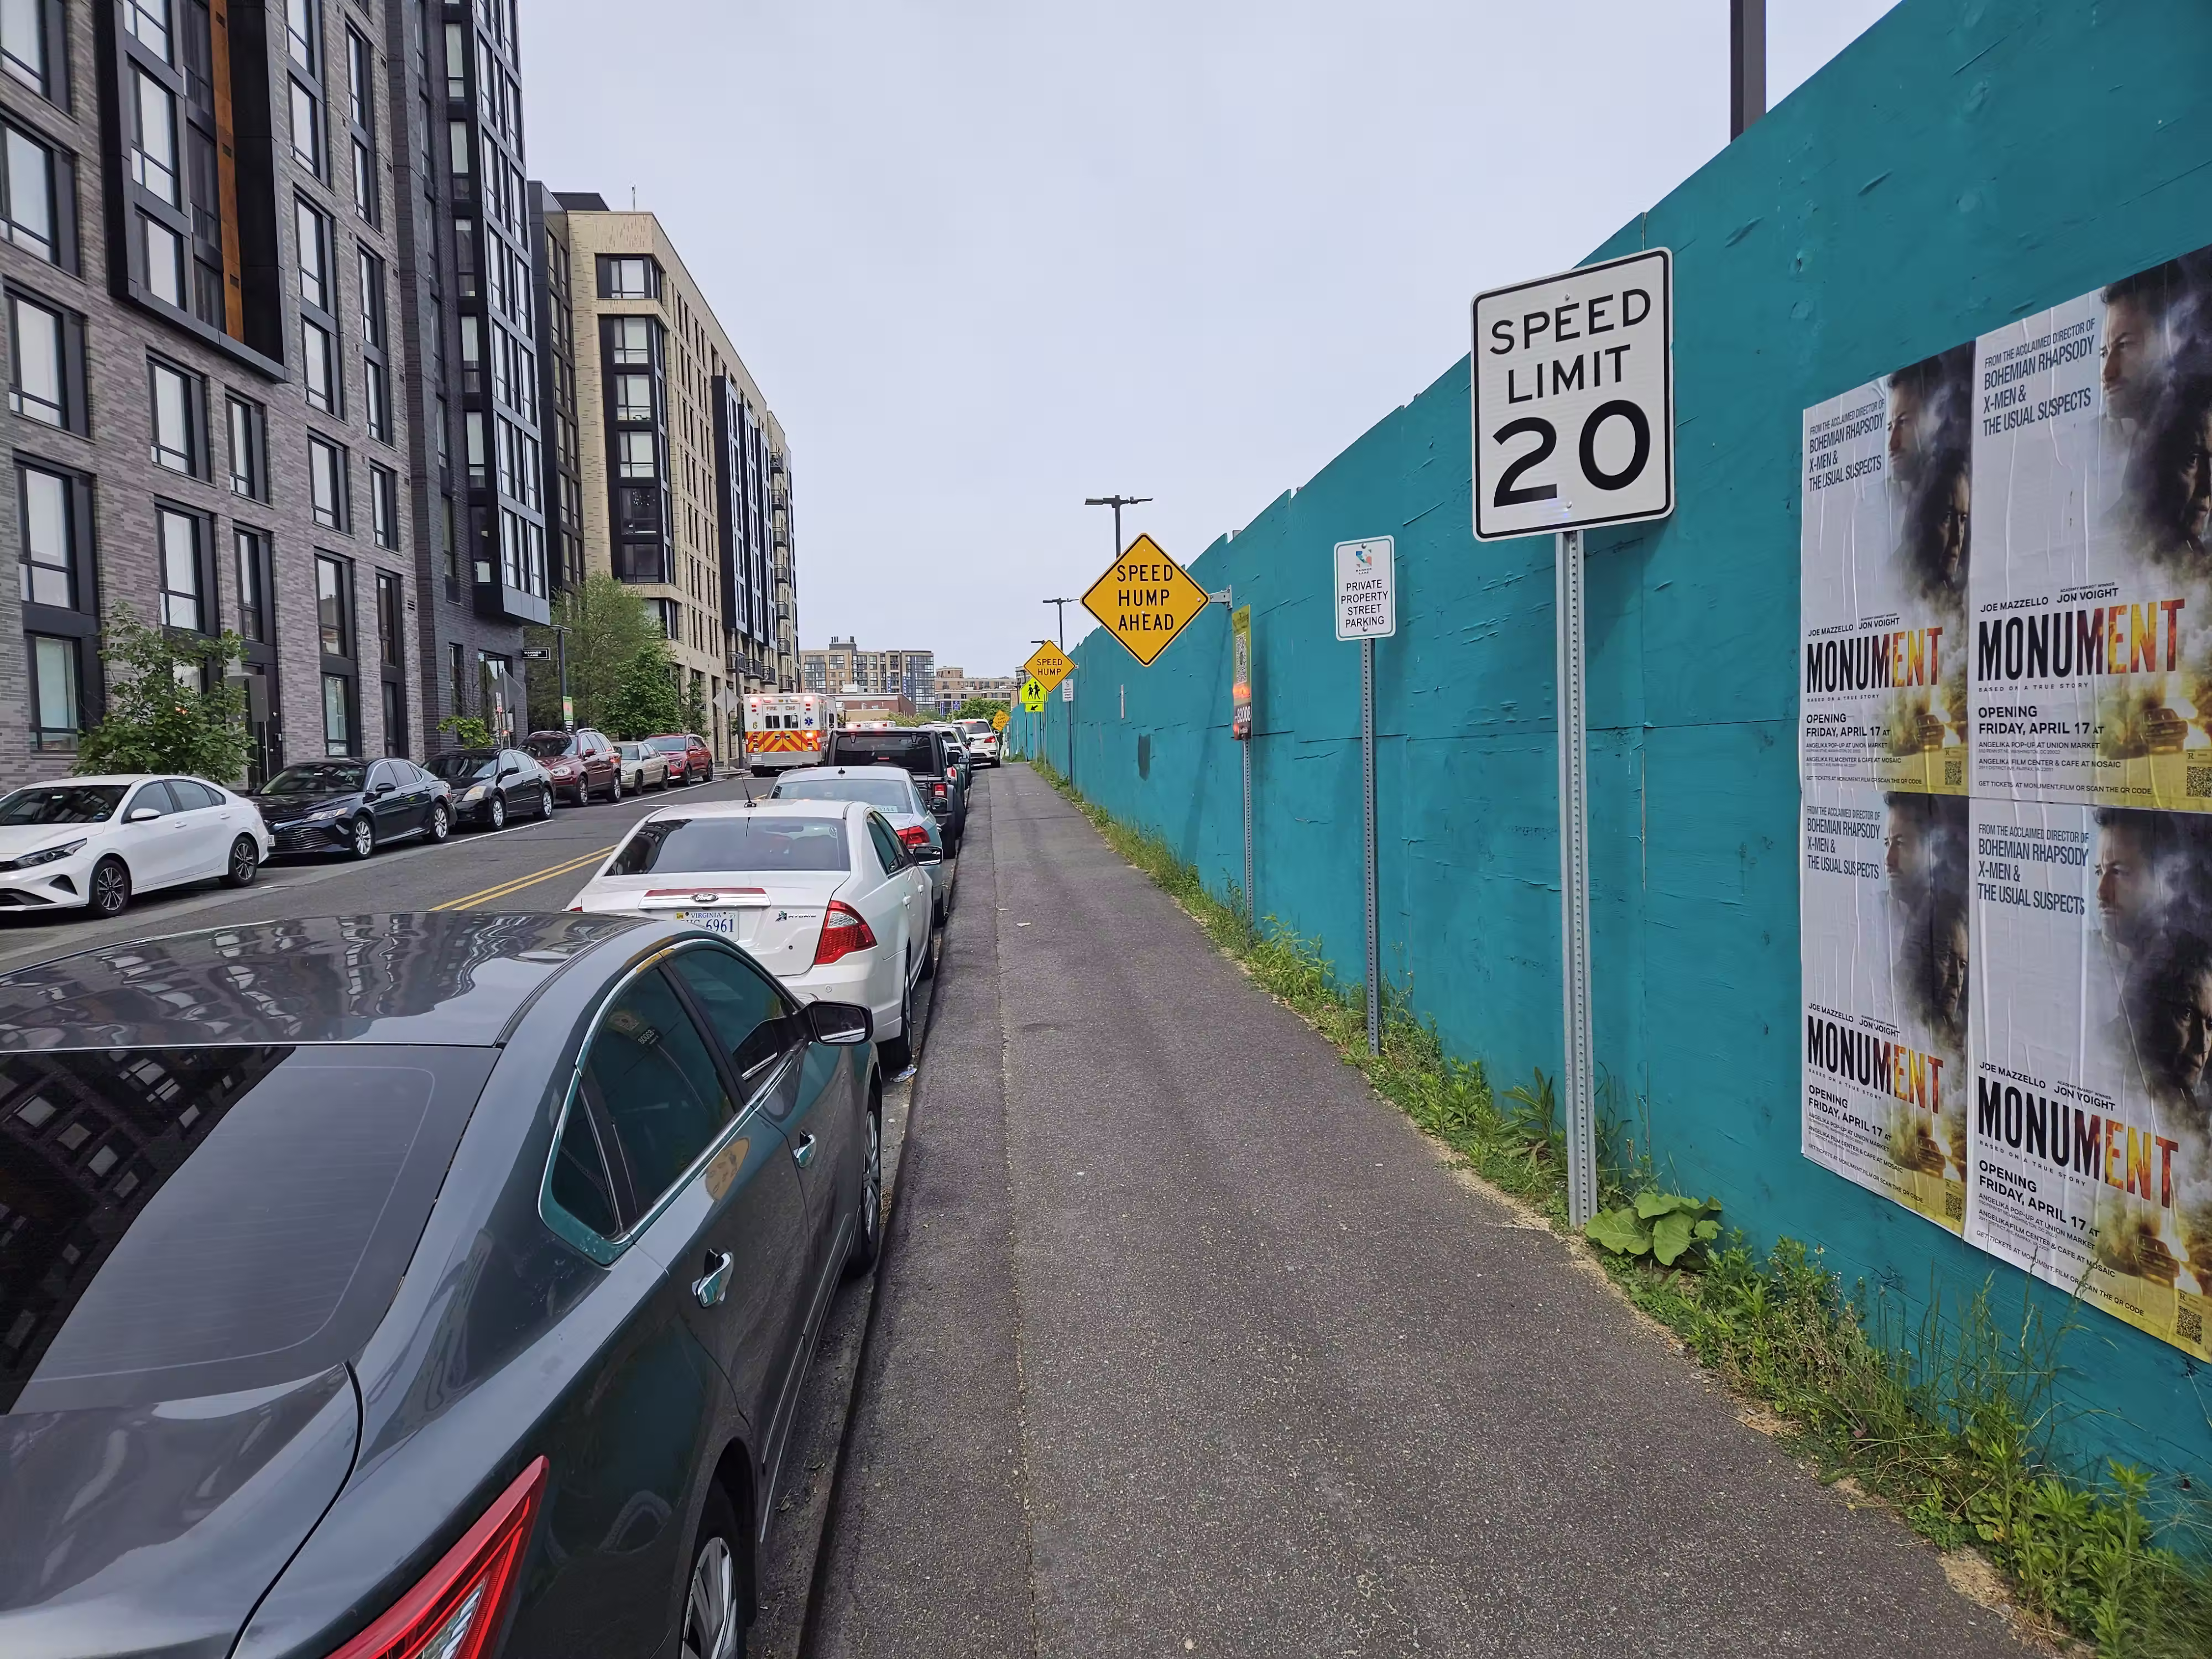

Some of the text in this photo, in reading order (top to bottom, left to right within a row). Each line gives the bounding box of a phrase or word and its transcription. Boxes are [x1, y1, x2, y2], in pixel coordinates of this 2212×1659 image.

[1490, 289, 1651, 354] SPEED
[1985, 318, 2095, 368] FROM THE ACCLAIMED DIRECTOR OF
[1509, 343, 1631, 404] LIMIT
[1984, 335, 2094, 390] BOHEMIAN RHAPSODY
[1984, 384, 2026, 414] X-MEN &
[1984, 388, 2091, 436] THE USUAL SUSPECTS
[1810, 413, 1884, 453] BOHEMIAN RHAPSODY
[1493, 399, 1650, 508] 20
[1809, 450, 1838, 473] X-MEN &
[1809, 455, 1881, 492] THE USUAL SUSPECTS
[1117, 565, 1173, 582] SPEED
[1346, 580, 1382, 592] PRIVATE
[1118, 589, 1170, 606] HUMP
[1341, 591, 1388, 604] PROPERTY
[1348, 604, 1381, 615] STREET
[1980, 588, 2119, 613] JOE MAZZELLO JON VOIGHT
[1118, 614, 1173, 631] AHEAD
[1345, 616, 1384, 628] PARKING
[1808, 618, 1900, 637] JOE MAZZELLO JON VOIGHT
[1978, 598, 2185, 681] MONUMENT
[1807, 627, 1943, 693] MONUMENT
[1807, 713, 1846, 723] OPENING
[1978, 706, 2037, 718] OPENING
[1806, 727, 1838, 738] FRIDAY,
[1841, 727, 1867, 737] APRIL
[1870, 727, 1880, 736] 17
[1979, 723, 2026, 735] FRIDAY,
[2030, 723, 2070, 734] APRIL
[2075, 722, 2090, 734] 17
[1807, 818, 1880, 839] BOHEMIAN RHAPSODY
[1979, 824, 2089, 843] FROM THE ACCLAIMED DIRECTOR OF
[1808, 836, 1835, 853] X-MEN &
[1979, 838, 2089, 867] BOHEMIAN RHAPSODY
[1808, 855, 1879, 879] THE USUAL SUSPECTS
[1978, 860, 2020, 882] X-MEN &
[1978, 883, 2084, 915] THE USUAL SUSPECTS
[1808, 1003, 1820, 1012] JOE
[1822, 1006, 1854, 1022] MAZZELLO
[1859, 1019, 1873, 1029] JON
[1875, 1024, 1900, 1038] VOIGHT
[1808, 1015, 1943, 1114] MONUMENT
[1809, 1084, 1848, 1108] OPENING
[1980, 1062, 2115, 1111] JOE MAZZELLO JON VOIGHT
[1809, 1097, 1892, 1142] FRIDAY, APRIL 17 AT
[1978, 1076, 2178, 1209] MONUMENT
[1979, 1160, 2037, 1192] OPENING
[1980, 1140, 2004, 1154] BASED
[2008, 1151, 2019, 1160] ON
[2032, 1161, 2053, 1174] TRUE
[2059, 1172, 2086, 1187] STORY
[1979, 1175, 2100, 1237] FRIDAY, APRIL 17 AT
[1979, 1193, 2008, 1211] ANGELIKA
[2010, 1206, 2034, 1222] POP-UP
[2045, 1220, 2065, 1237] UNION
[2067, 1233, 2095, 1250] MARKET
[1979, 1209, 2009, 1228] ANGELIKA
[2010, 1224, 2025, 1234] FILM
[2026, 1231, 2050, 1246] CENTER
[2058, 1245, 2075, 1259] CAFE
[2077, 1254, 2085, 1263] AT
[2086, 1259, 2115, 1277] MOSAIC
[2179, 1292, 2186, 1301] R
